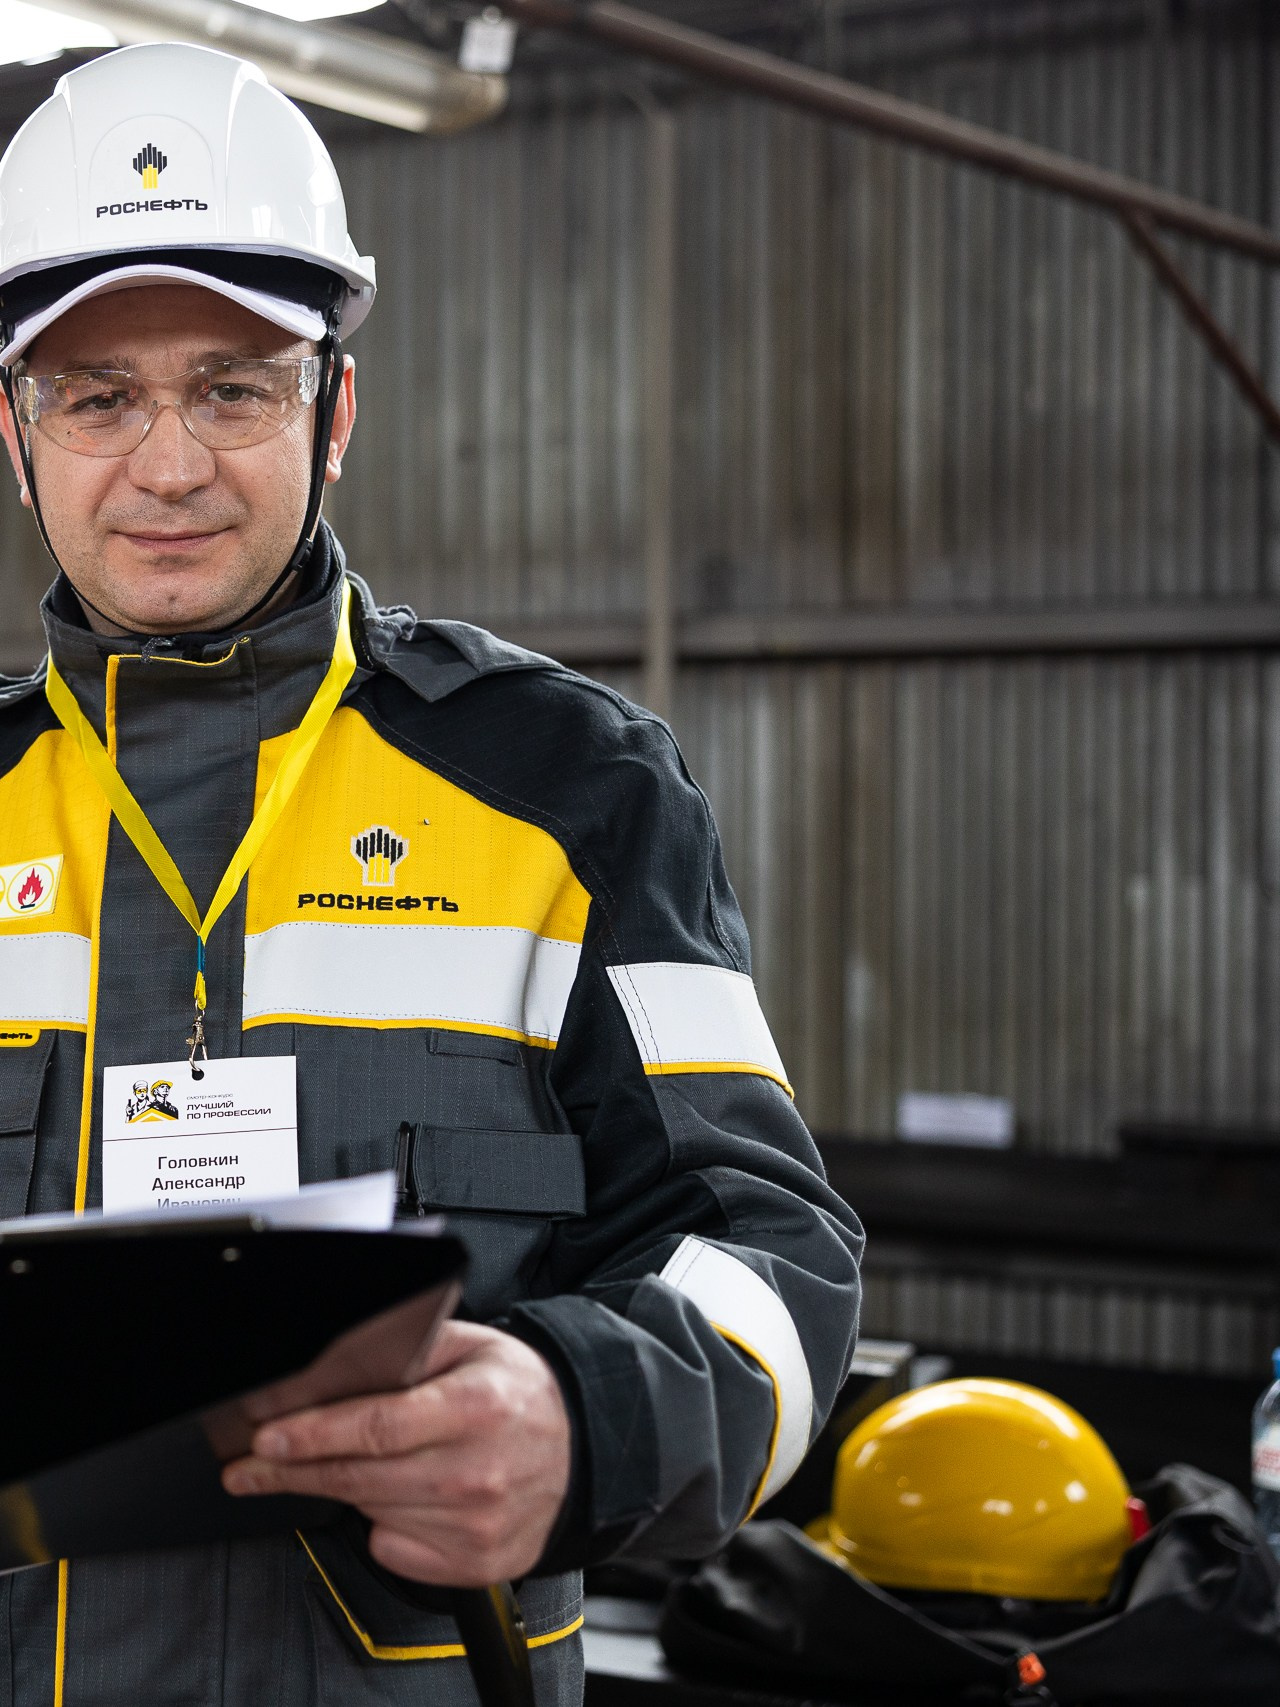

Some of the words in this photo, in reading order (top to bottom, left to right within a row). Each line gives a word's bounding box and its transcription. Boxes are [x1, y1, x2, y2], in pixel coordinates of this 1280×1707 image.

[96, 199, 208, 218] РОСНЕФТЬ
[297, 893, 459, 912] РОСНЕФТЬ
[186, 1100, 234, 1111] ЛУЧШИЙ
[203, 1108, 272, 1119] ПРОФЕССИИ
[157, 1155, 239, 1170] Головкин
[151, 1175, 246, 1191] Александр
